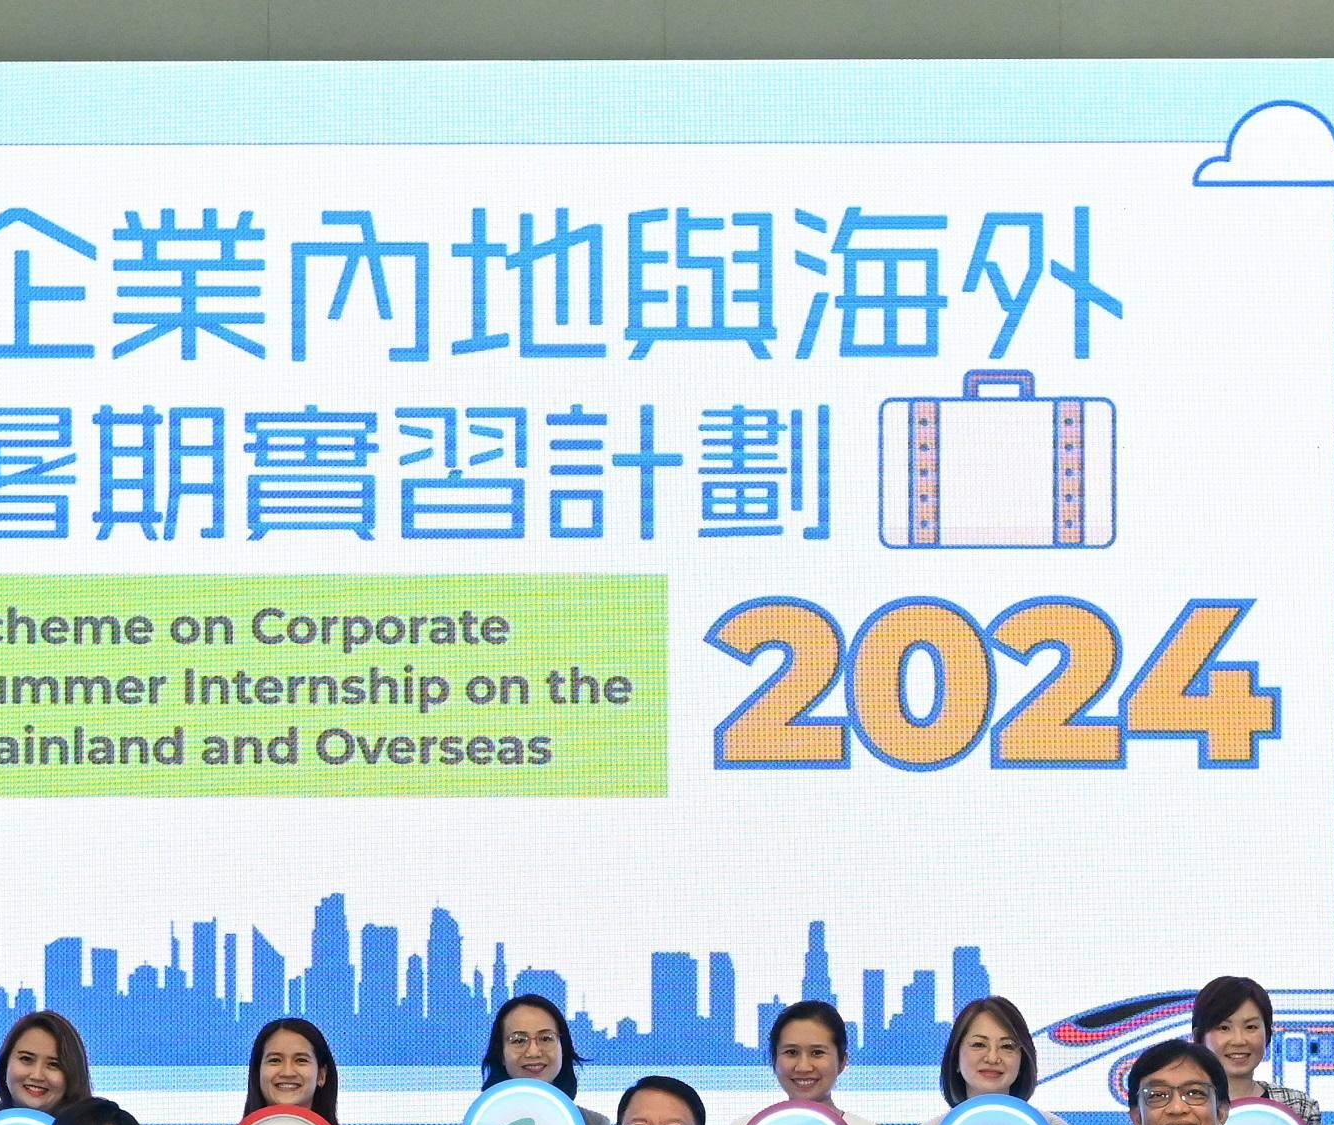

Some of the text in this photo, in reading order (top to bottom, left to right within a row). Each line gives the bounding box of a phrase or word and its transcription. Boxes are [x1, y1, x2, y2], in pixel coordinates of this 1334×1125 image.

[170, 615, 234, 645] on
[251, 606, 511, 654] Corporate
[185, 664, 451, 713] Internship
[466, 675, 529, 704] on
[546, 666, 634, 705] the
[702, 595, 1282, 773] 2024
[201, 726, 299, 766] and
[315, 728, 554, 766] Overseas
